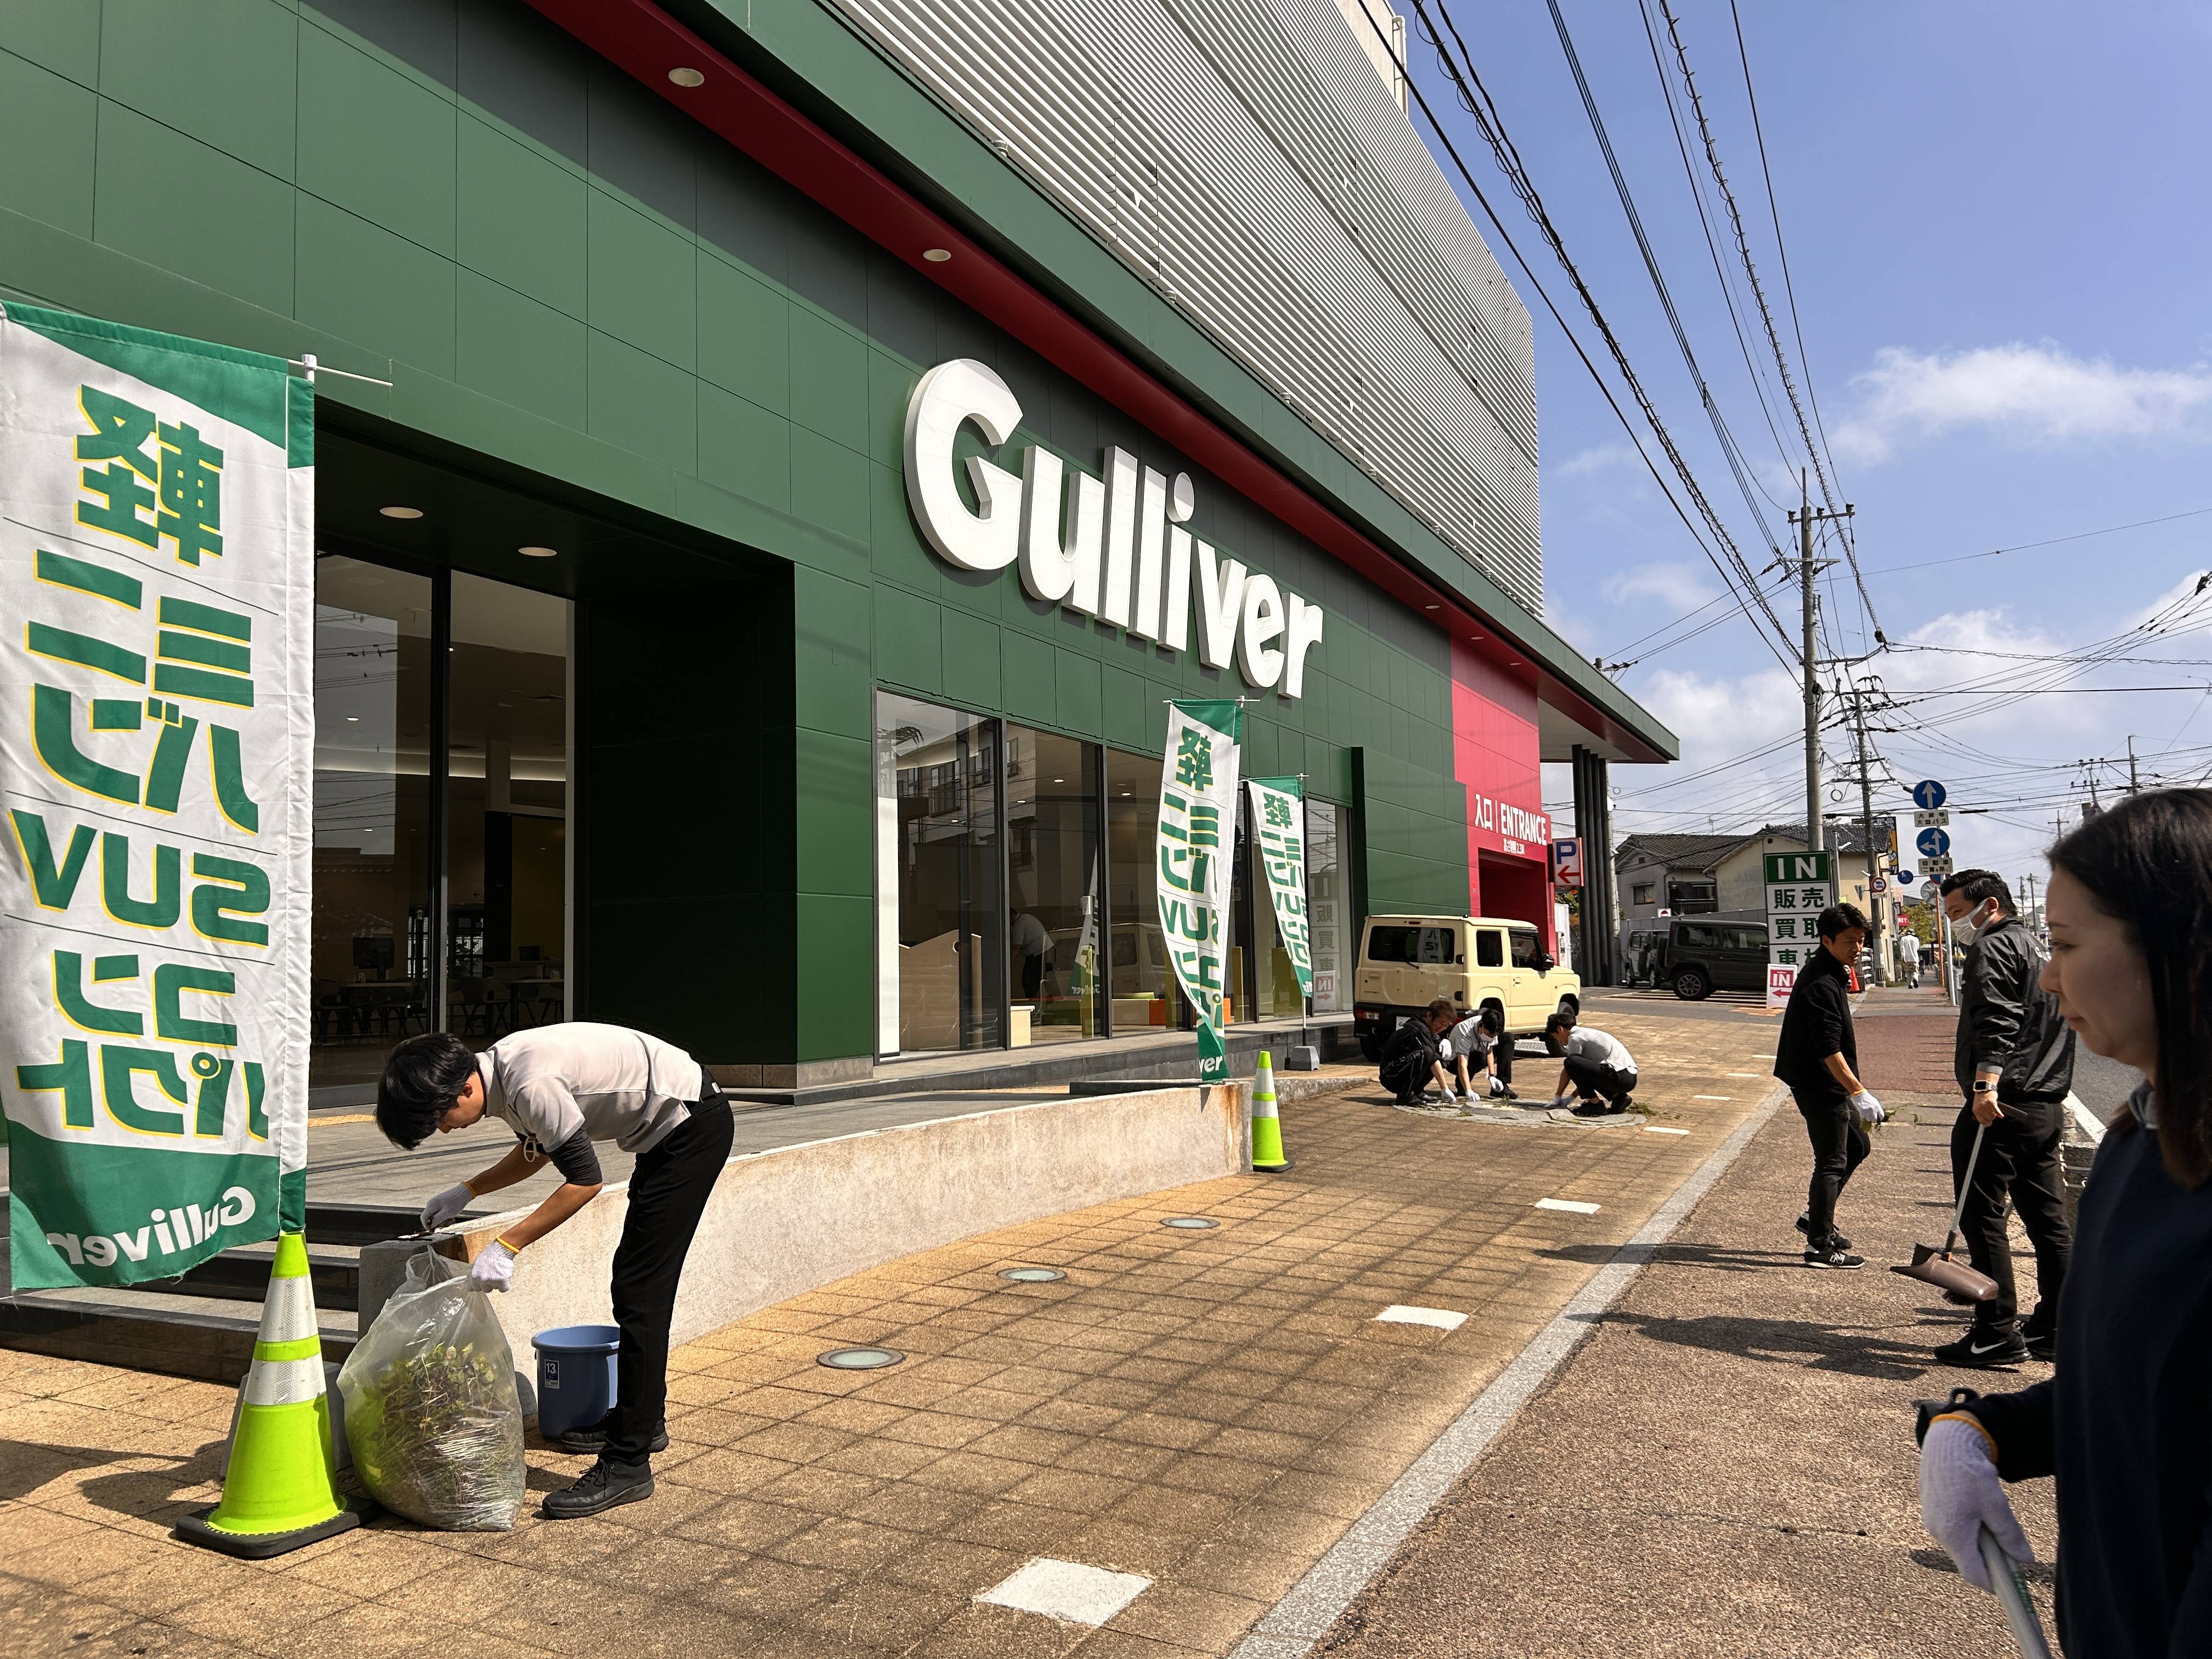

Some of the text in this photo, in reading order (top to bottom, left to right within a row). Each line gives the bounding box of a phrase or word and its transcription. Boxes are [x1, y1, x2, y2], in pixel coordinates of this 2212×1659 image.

[904, 358, 1323, 699] Gulliver
[1475, 793, 1548, 846] 入口 ENTRANCE
[1556, 841, 1577, 865] P
[1777, 856, 1817, 879] IN
[1774, 887, 1825, 909] 販売
[1773, 973, 1791, 986] IN
[545, 1363, 556, 1374] 13
